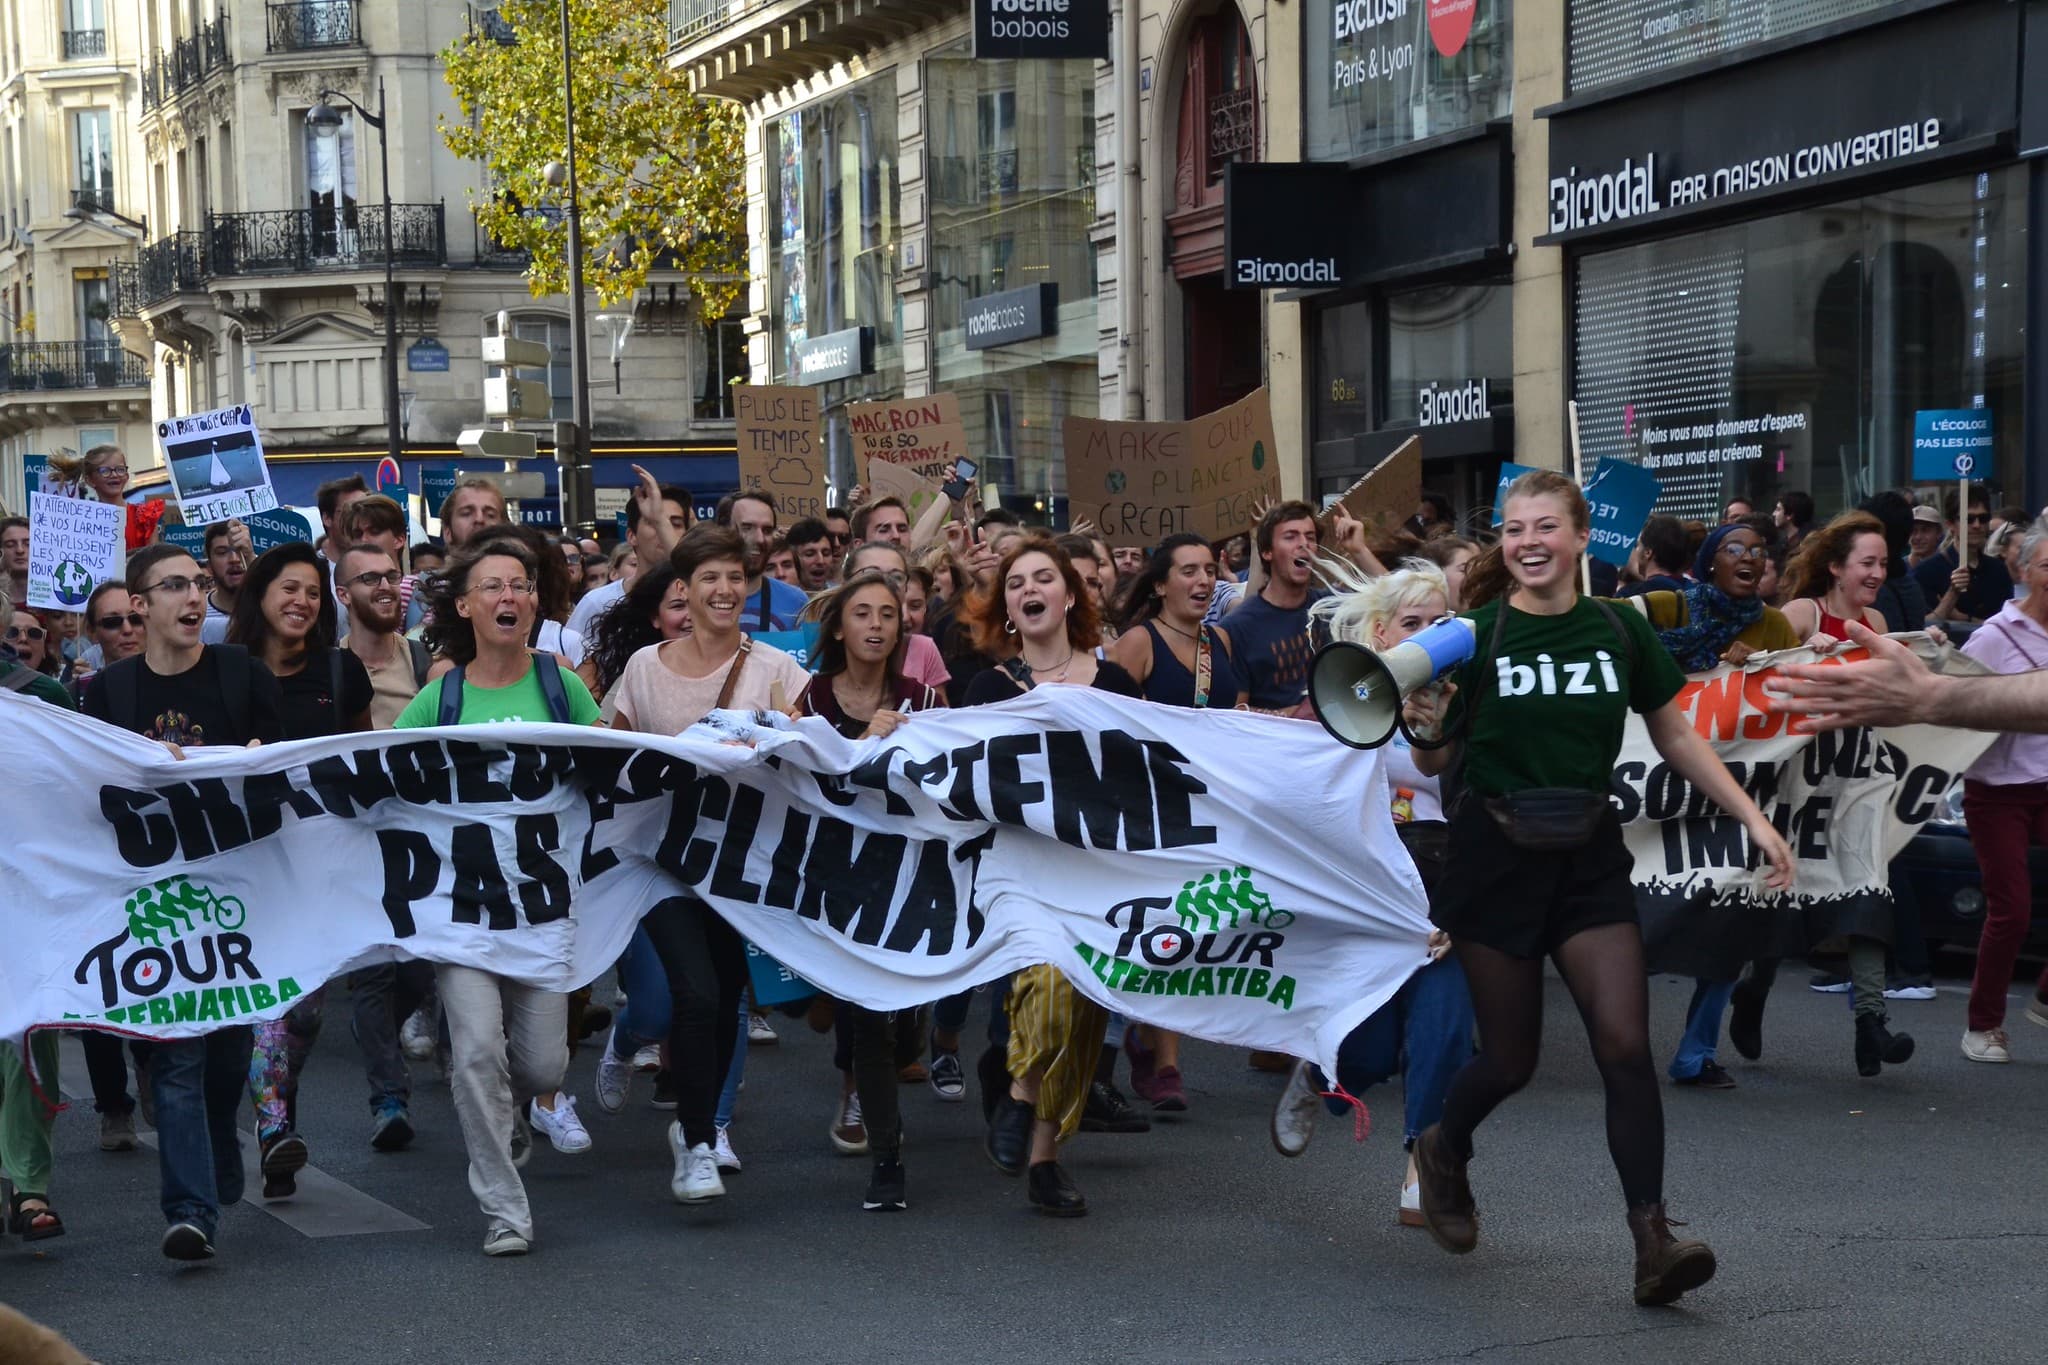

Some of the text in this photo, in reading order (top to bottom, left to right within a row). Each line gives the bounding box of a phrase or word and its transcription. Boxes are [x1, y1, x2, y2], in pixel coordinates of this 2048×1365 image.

[992, 16, 1069, 38] bobois
[1336, 0, 1406, 39] EXCLUSI
[1335, 43, 1413, 90] Paris & Lyon
[1670, 175, 1707, 208] PAR
[1331, 378, 1345, 401] 68
[739, 395, 812, 422] PLUS LE
[850, 403, 941, 433] MACRON
[747, 428, 811, 454] TEMPS
[862, 433, 919, 448] TU ES SO
[1085, 407, 1254, 461] MAKE OUR
[1642, 412, 1807, 445] Moins vous nous donnerez d'espace,
[1662, 452, 1683, 467] nous
[1685, 450, 1706, 465] vous
[1708, 450, 1720, 463] en
[1721, 443, 1763, 462] créerons
[1916, 438, 1940, 448] PAS
[1941, 438, 1963, 448] LES
[746, 474, 761, 488] DE
[1152, 456, 1248, 496] PLANET
[95, 507, 120, 523] PAS
[1100, 502, 1190, 536] GREAT
[1598, 505, 1620, 520] LE
[50, 516, 69, 530] VOS
[73, 519, 118, 541] LARMES
[253, 535, 268, 549] LE
[32, 546, 54, 562] LES
[33, 528, 115, 557] REMPLISSENT
[31, 561, 54, 577] POUR
[1495, 650, 1620, 697] bizi
[376, 813, 572, 938] PAS
[1104, 896, 1285, 968] TOUR
[74, 926, 262, 1008] TOUR
